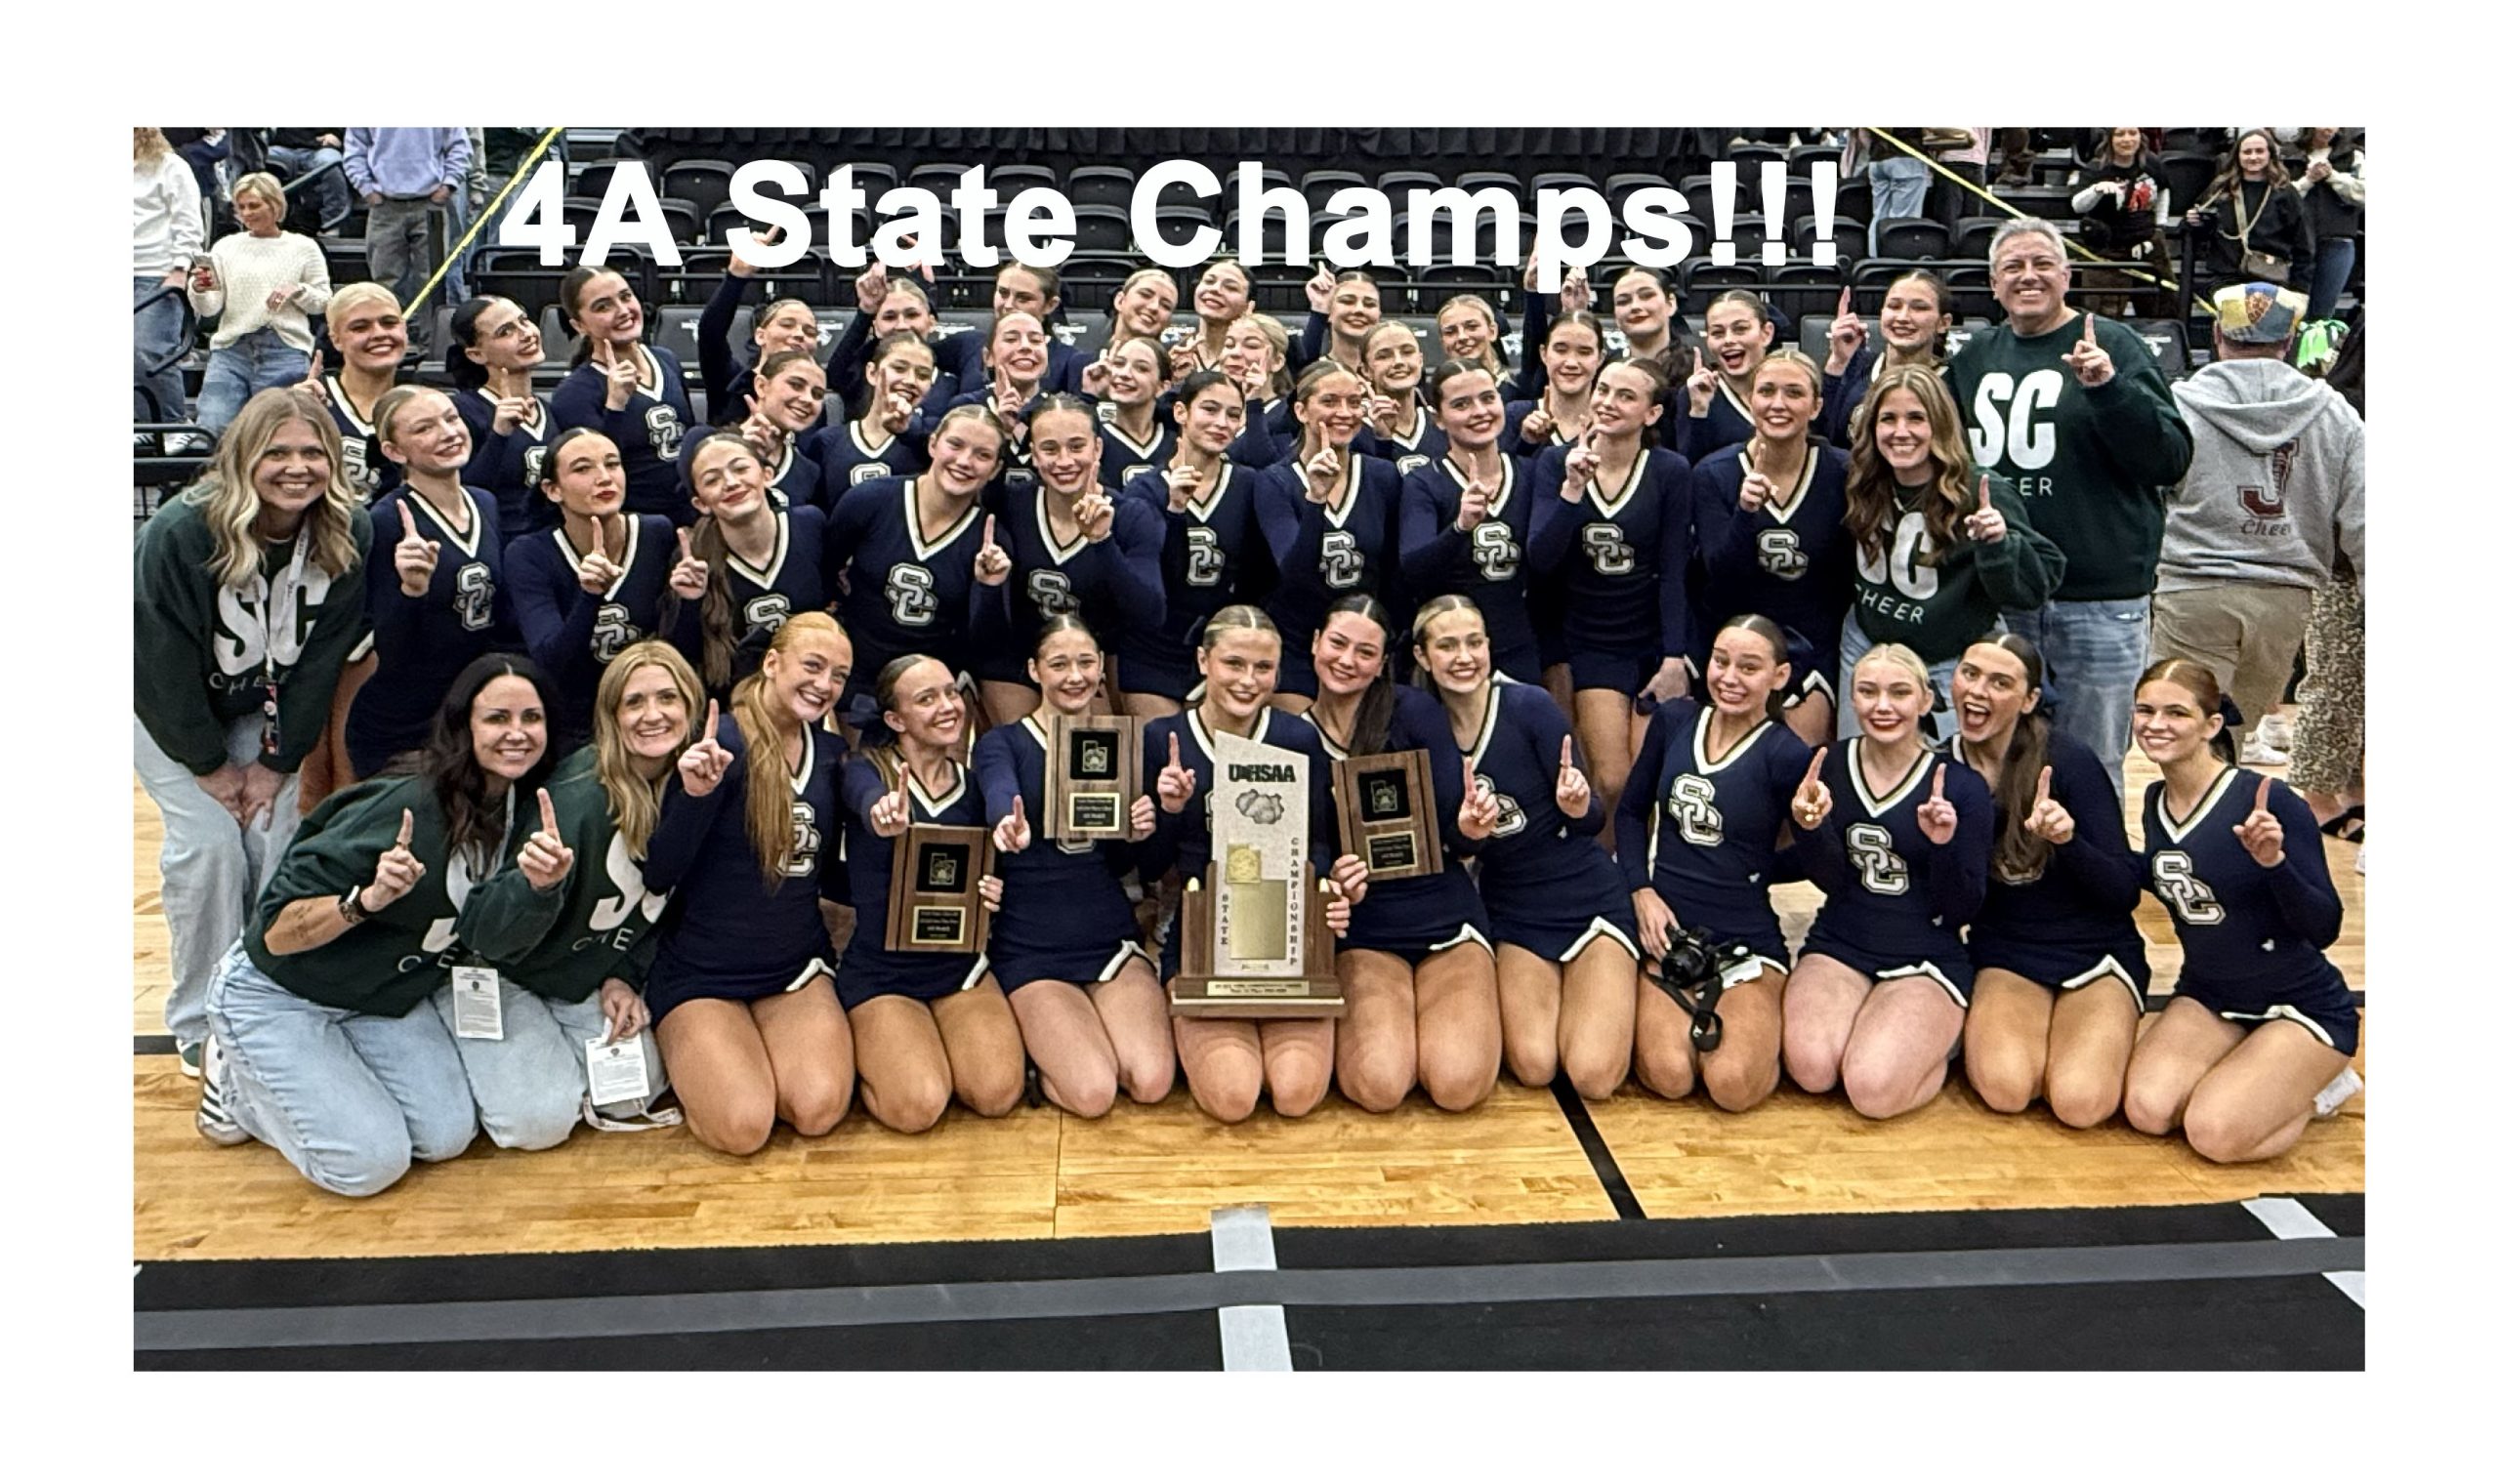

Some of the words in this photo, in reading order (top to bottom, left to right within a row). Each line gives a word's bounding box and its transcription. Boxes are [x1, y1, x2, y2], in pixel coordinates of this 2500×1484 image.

[645, 403, 687, 462] SC
[1968, 369, 2063, 471] SC
[1318, 531, 1364, 588] SC
[1473, 521, 1521, 581] SC
[1582, 522, 1635, 575] SC
[1757, 529, 1809, 581] SC
[213, 570, 331, 676] SC
[453, 562, 496, 633] SC
[885, 562, 938, 626] SC
[1854, 583, 1926, 625] HEER
[1669, 773, 1724, 846] SC
[1847, 823, 1910, 895] SC
[2152, 849, 2226, 926] SC
[1221, 893, 1229, 946] STATE
[1289, 837, 1300, 967] CHAMPIONSHIP
